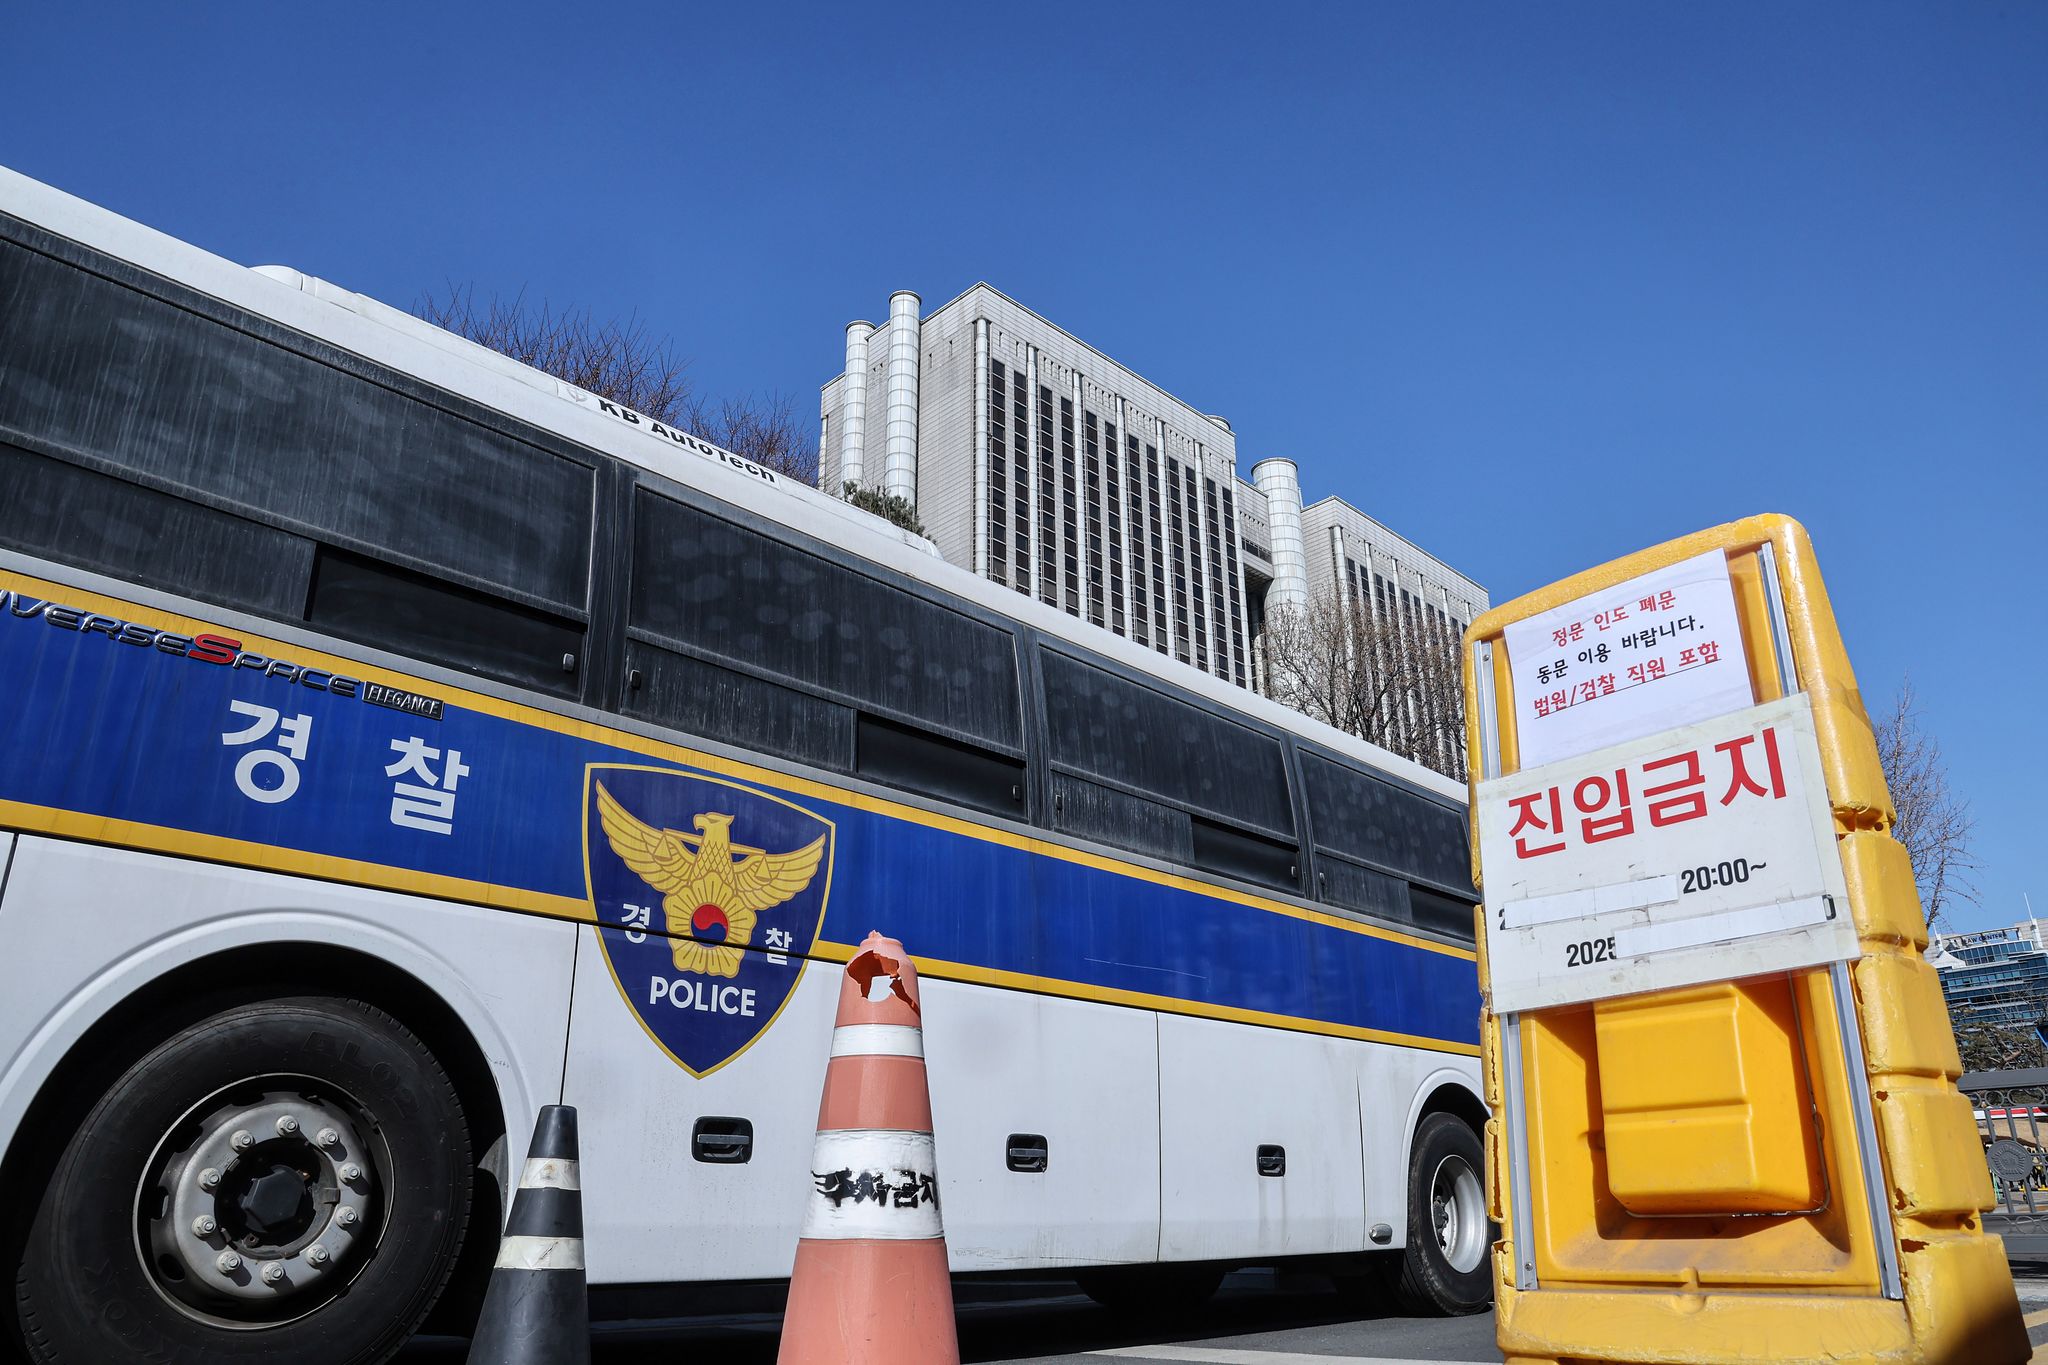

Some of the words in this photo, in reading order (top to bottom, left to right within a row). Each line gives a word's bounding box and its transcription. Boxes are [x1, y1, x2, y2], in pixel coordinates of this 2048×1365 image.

[598, 398, 640, 425] KB
[651, 422, 776, 484] AutoTech
[1536, 658, 1569, 685] 동문
[1577, 643, 1611, 664] 이용
[1621, 615, 1705, 650] 바랍니다.
[1552, 621, 1585, 647] 정문
[1594, 606, 1630, 632] 인도
[1639, 590, 1676, 613] 폐문
[367, 685, 440, 715] ELEGANCE
[1534, 672, 1616, 717] 법원/검찰
[1627, 656, 1666, 684] 직원
[1678, 640, 1719, 668] 포함
[1508, 727, 1787, 860] 진입금지
[1681, 857, 1767, 895] 20:00~
[649, 975, 756, 1017] POLICE
